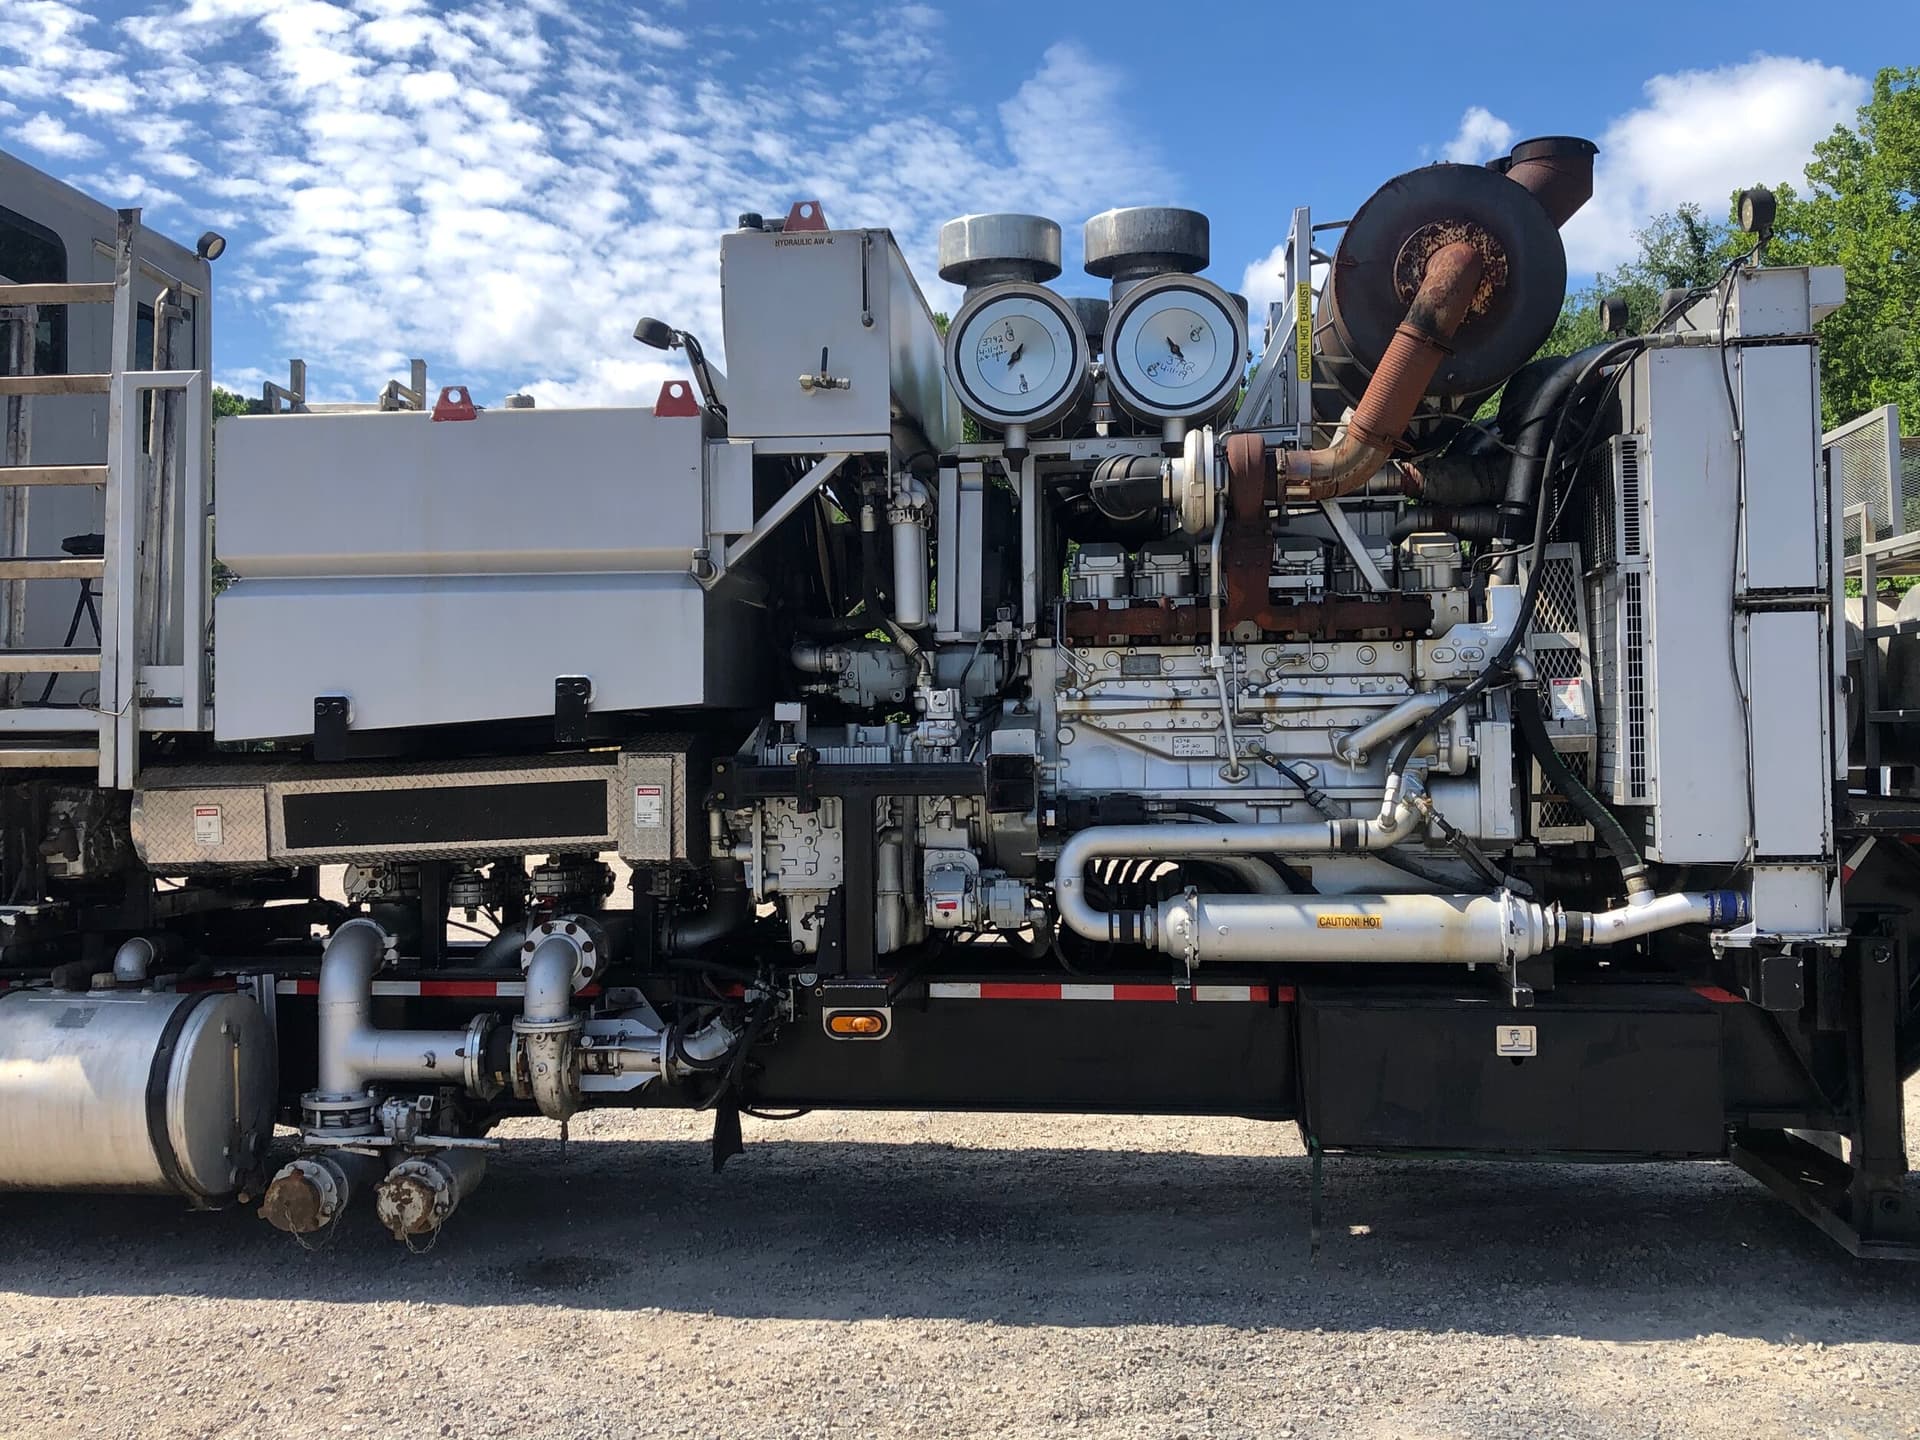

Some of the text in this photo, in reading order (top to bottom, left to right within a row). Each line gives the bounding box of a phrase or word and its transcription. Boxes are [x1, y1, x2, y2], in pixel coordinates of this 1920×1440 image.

[774, 238, 812, 247] HYDRAULIC
[1300, 324, 1309, 340] HOT
[1319, 916, 1381, 927] CAUTION! HOT
